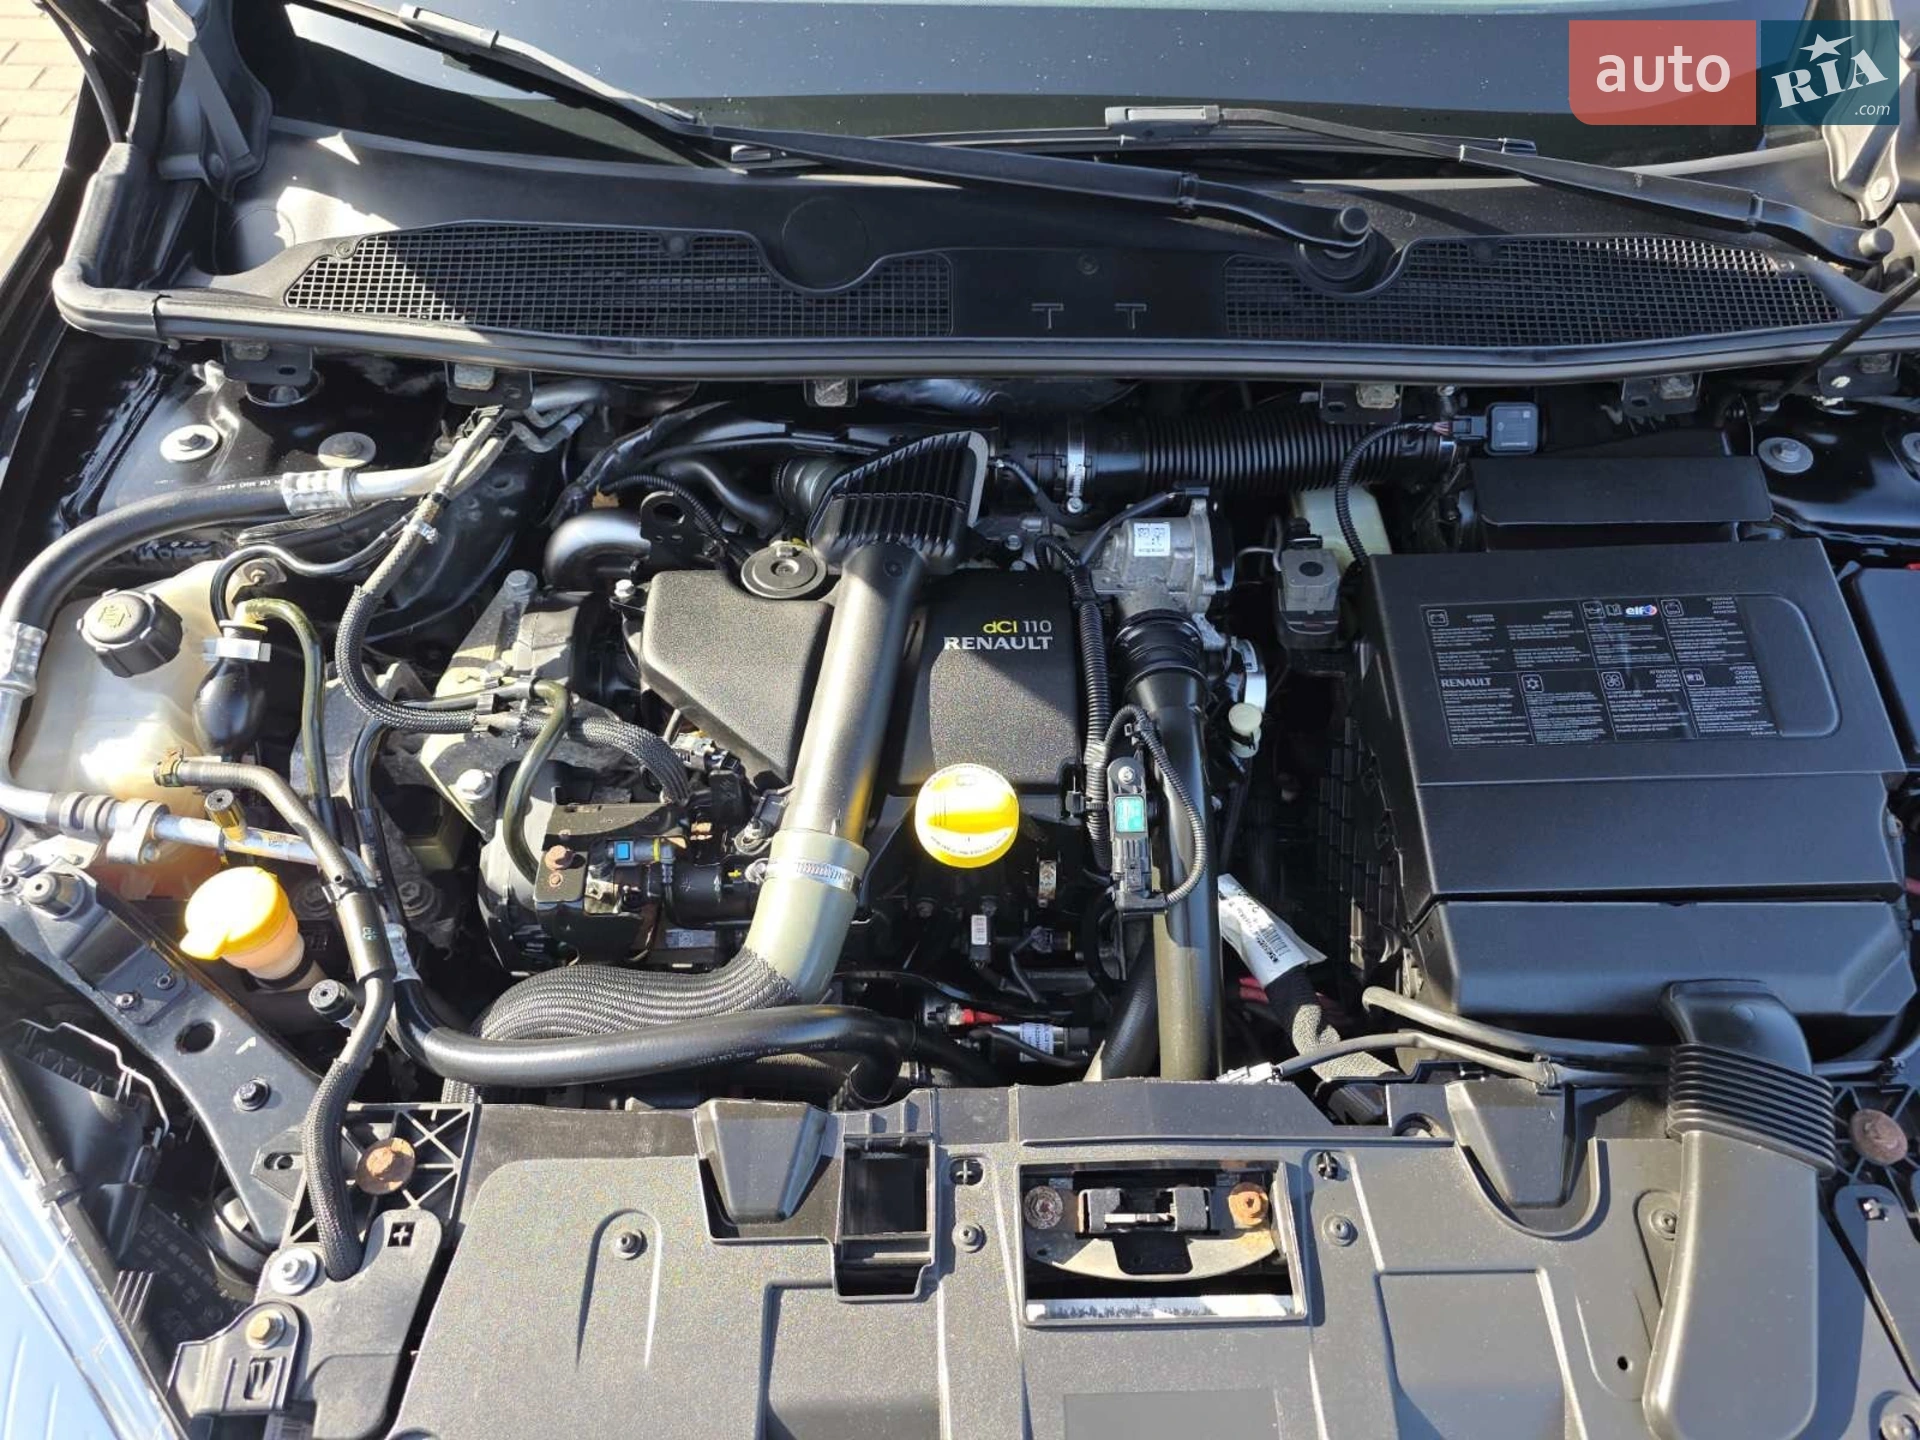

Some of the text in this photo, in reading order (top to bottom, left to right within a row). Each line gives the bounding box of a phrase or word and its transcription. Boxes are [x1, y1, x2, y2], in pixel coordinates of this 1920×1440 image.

[1625, 605, 1647, 616] elf
[1022, 620, 1053, 633] 110
[943, 636, 1053, 650] RENAULT
[1440, 677, 1492, 688] RENAULT
